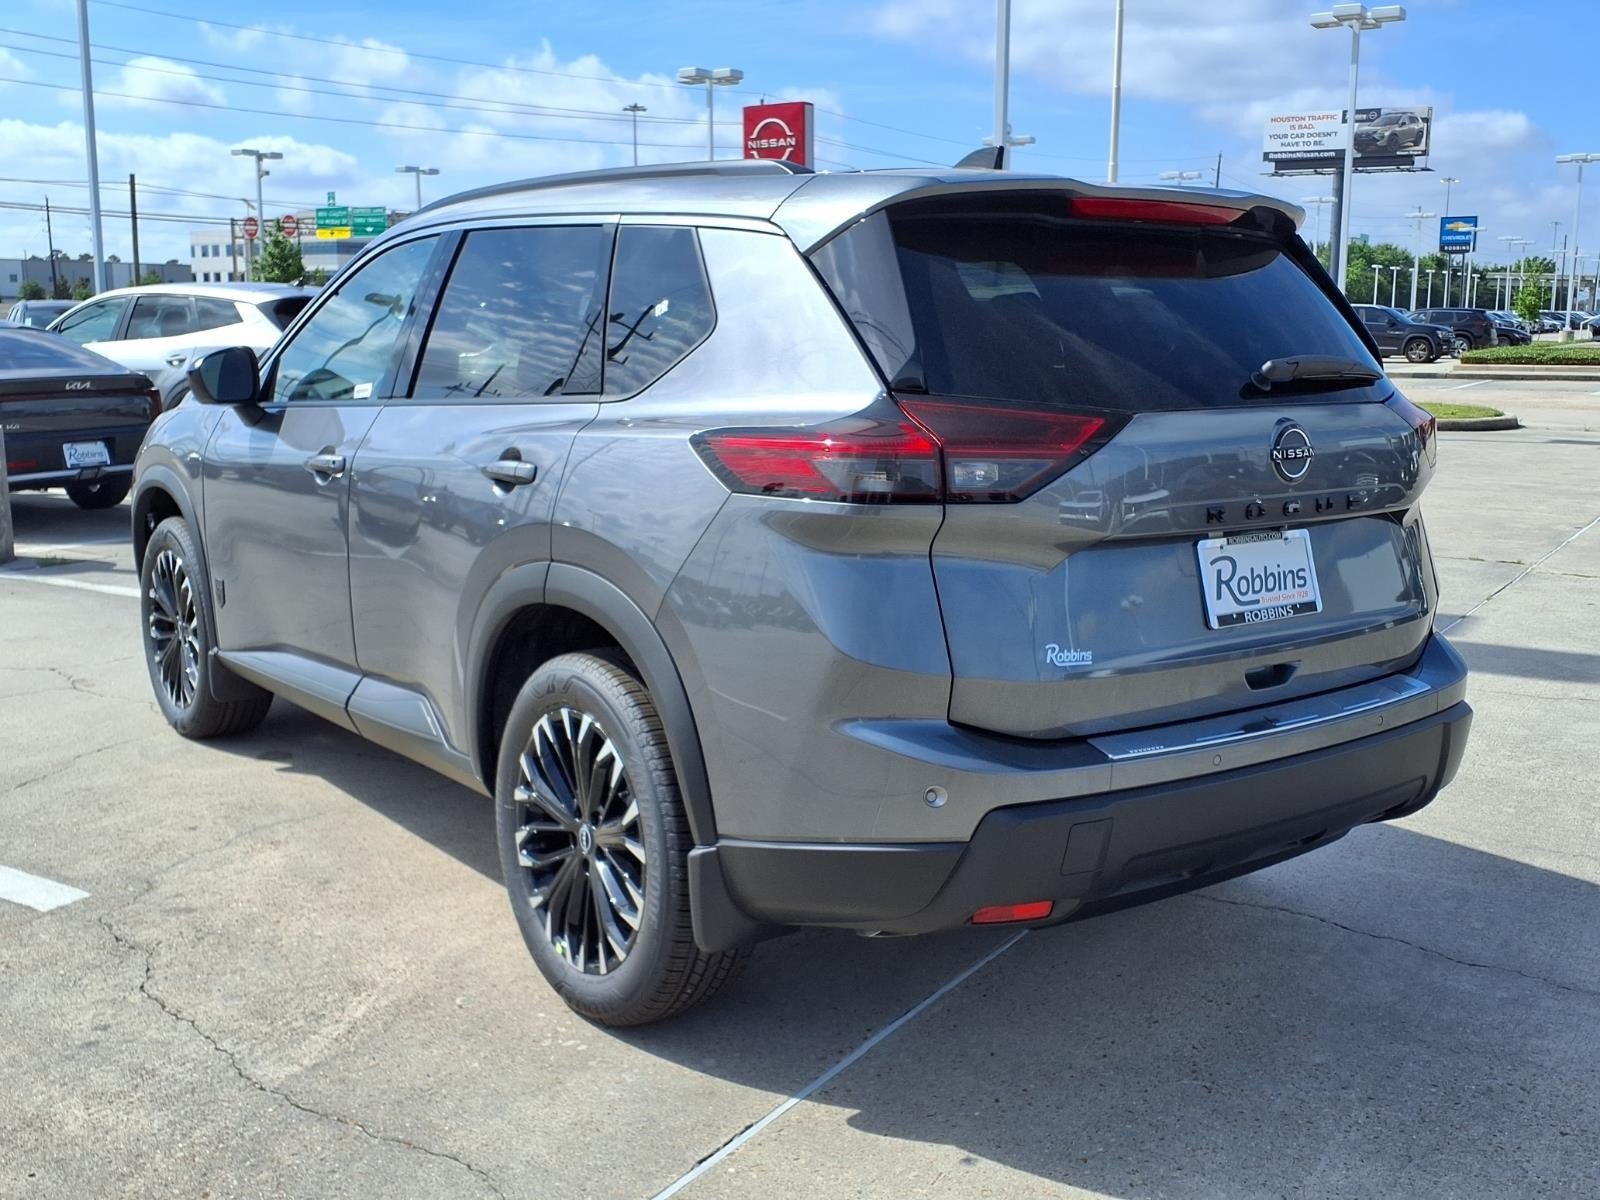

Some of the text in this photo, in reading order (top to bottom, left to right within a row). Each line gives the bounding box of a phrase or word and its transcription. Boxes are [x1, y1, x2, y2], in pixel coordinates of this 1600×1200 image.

[1306, 131, 1338, 139] DOESN'T
[748, 137, 796, 149] NISSAN
[1268, 151, 1336, 159] RobbinsNissan.com
[1273, 447, 1315, 460] NISSAN
[1206, 494, 1362, 525] ROGUE
[1209, 555, 1307, 607] Robbins
[1281, 593, 1296, 602] Since
[1244, 605, 1294, 622] ROBBINS
[1045, 643, 1093, 667] Robbins
